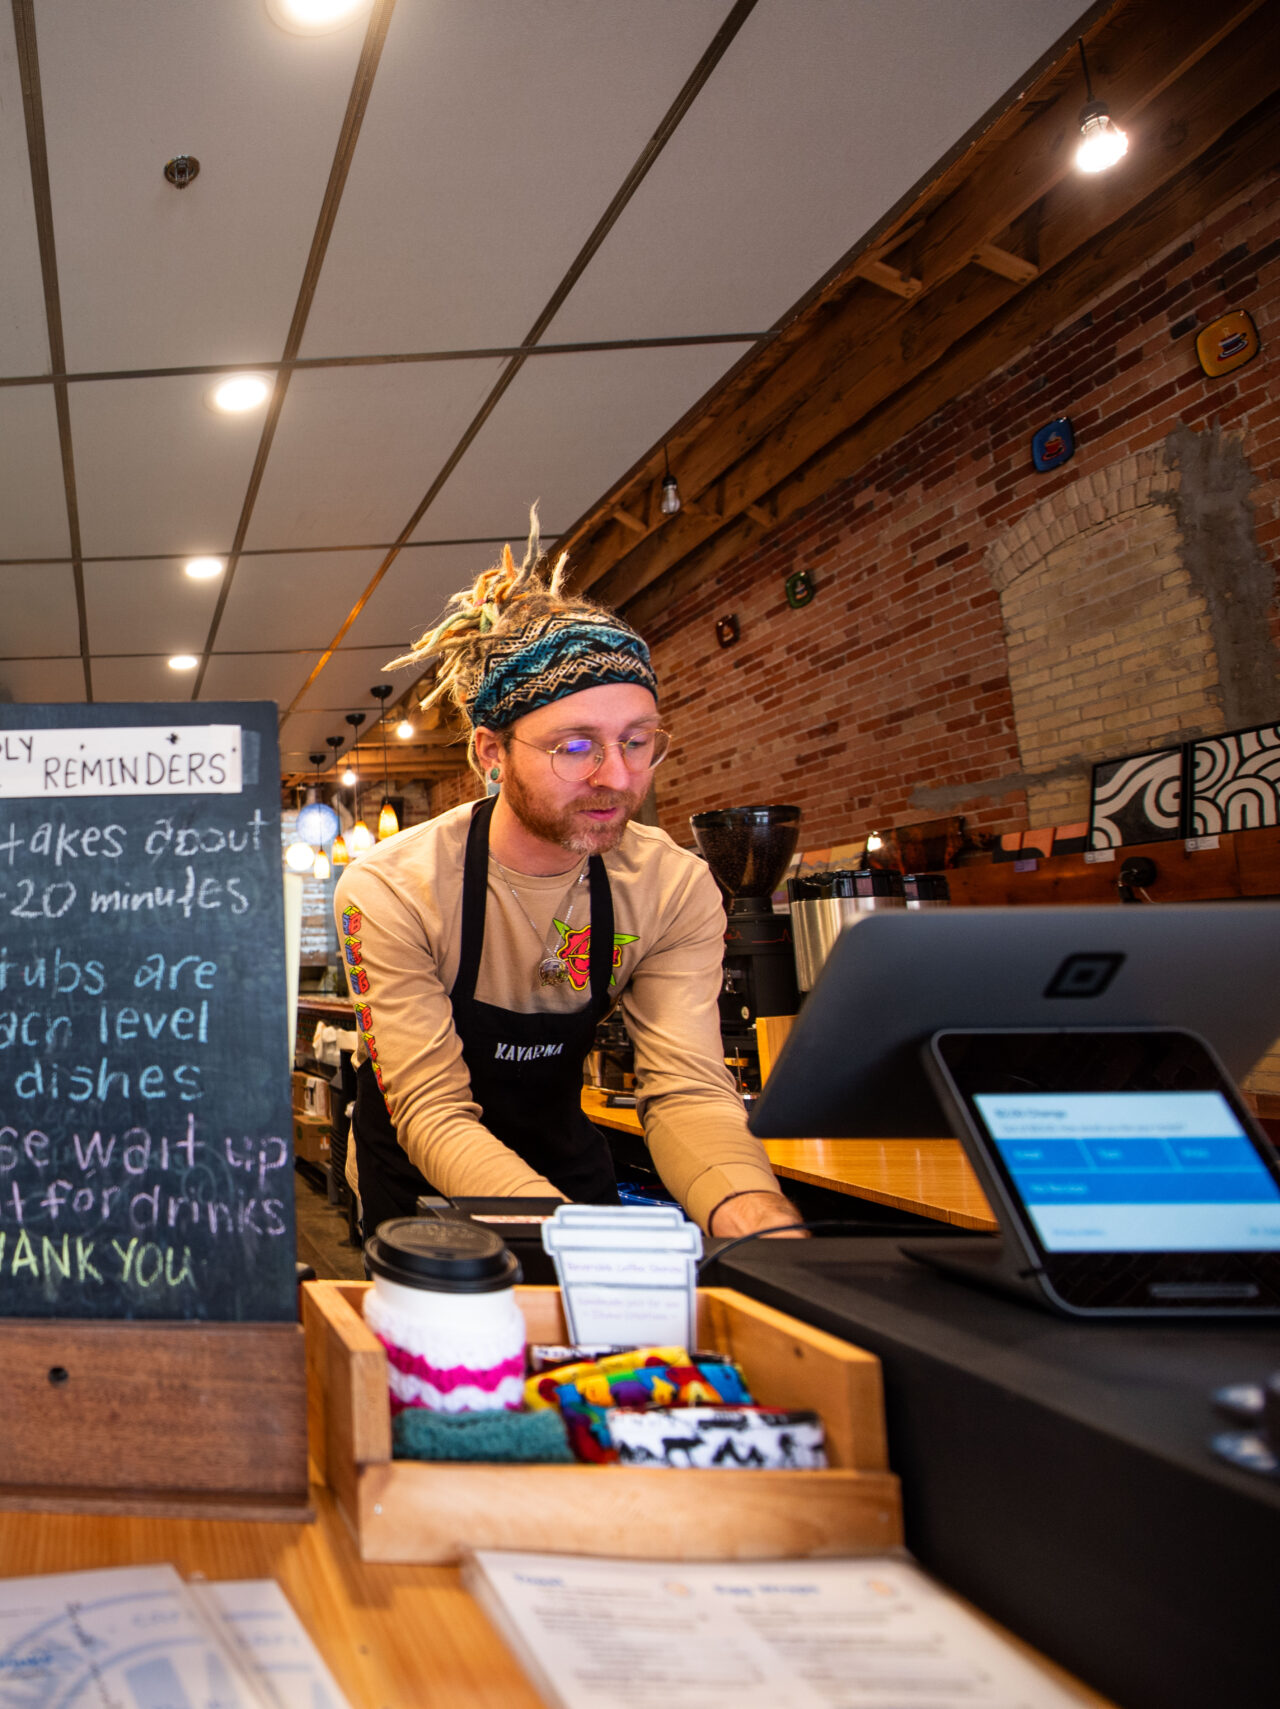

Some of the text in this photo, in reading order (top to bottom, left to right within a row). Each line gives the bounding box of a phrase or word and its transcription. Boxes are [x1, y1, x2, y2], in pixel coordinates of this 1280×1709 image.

[44, 752, 227, 790] REMINDERS
[145, 809, 268, 860] about
[90, 866, 249, 917] minutes
[134, 952, 219, 992] are
[99, 999, 208, 1044] level
[494, 1042, 564, 1062] KAVARNA
[14, 1057, 205, 1101] dishes
[73, 1112, 205, 1174] wait
[225, 1136, 288, 1190] up
[40, 1179, 120, 1219] for
[130, 1185, 287, 1236] drinks
